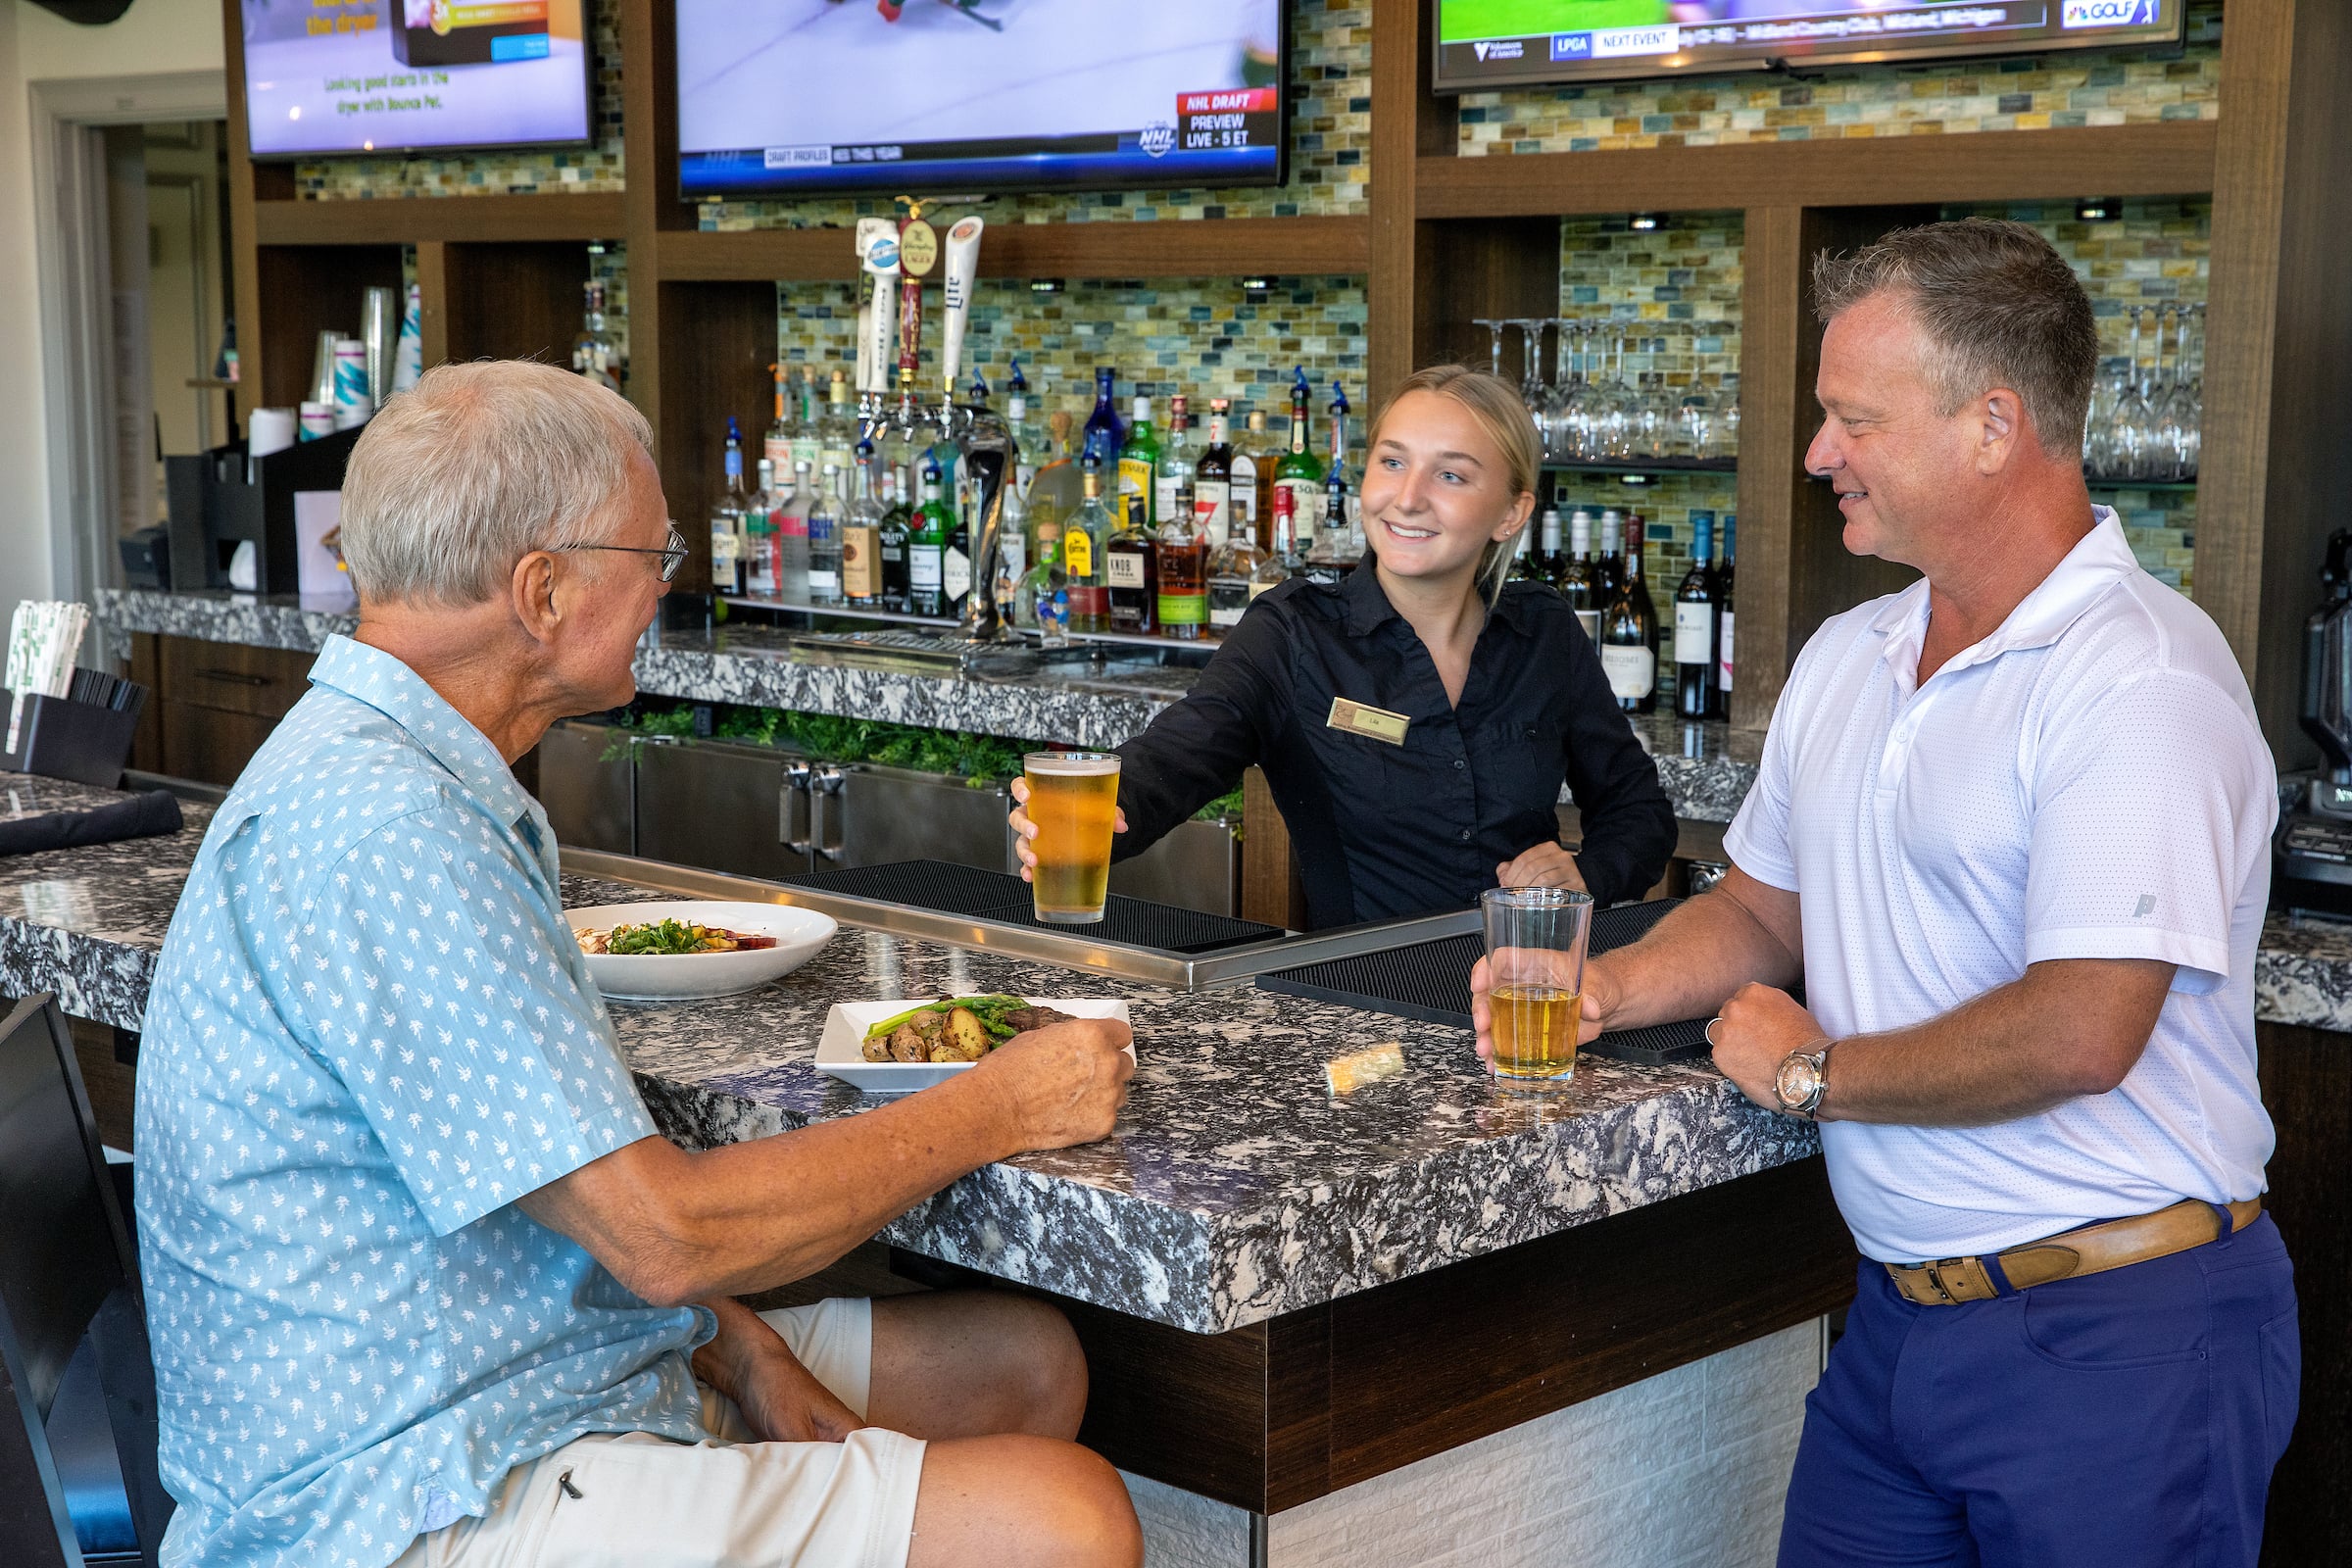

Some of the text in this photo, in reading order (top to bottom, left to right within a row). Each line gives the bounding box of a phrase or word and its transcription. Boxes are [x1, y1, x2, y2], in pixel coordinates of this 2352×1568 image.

[2090, 1, 2132, 19] GOLF
[306, 12, 377, 38] the dryer
[1557, 31, 1666, 53] LPGA NEXT EVENT
[365, 74, 387, 92] good
[364, 98, 383, 111] with
[388, 96, 420, 110] Bounce
[1187, 93, 1250, 111] NHL DRAFT
[1191, 113, 1246, 130] PREVIEW
[1139, 129, 1175, 146] NHL
[1186, 130, 1249, 148] LIVE 5 ET
[1110, 559, 1132, 571] KNOB
